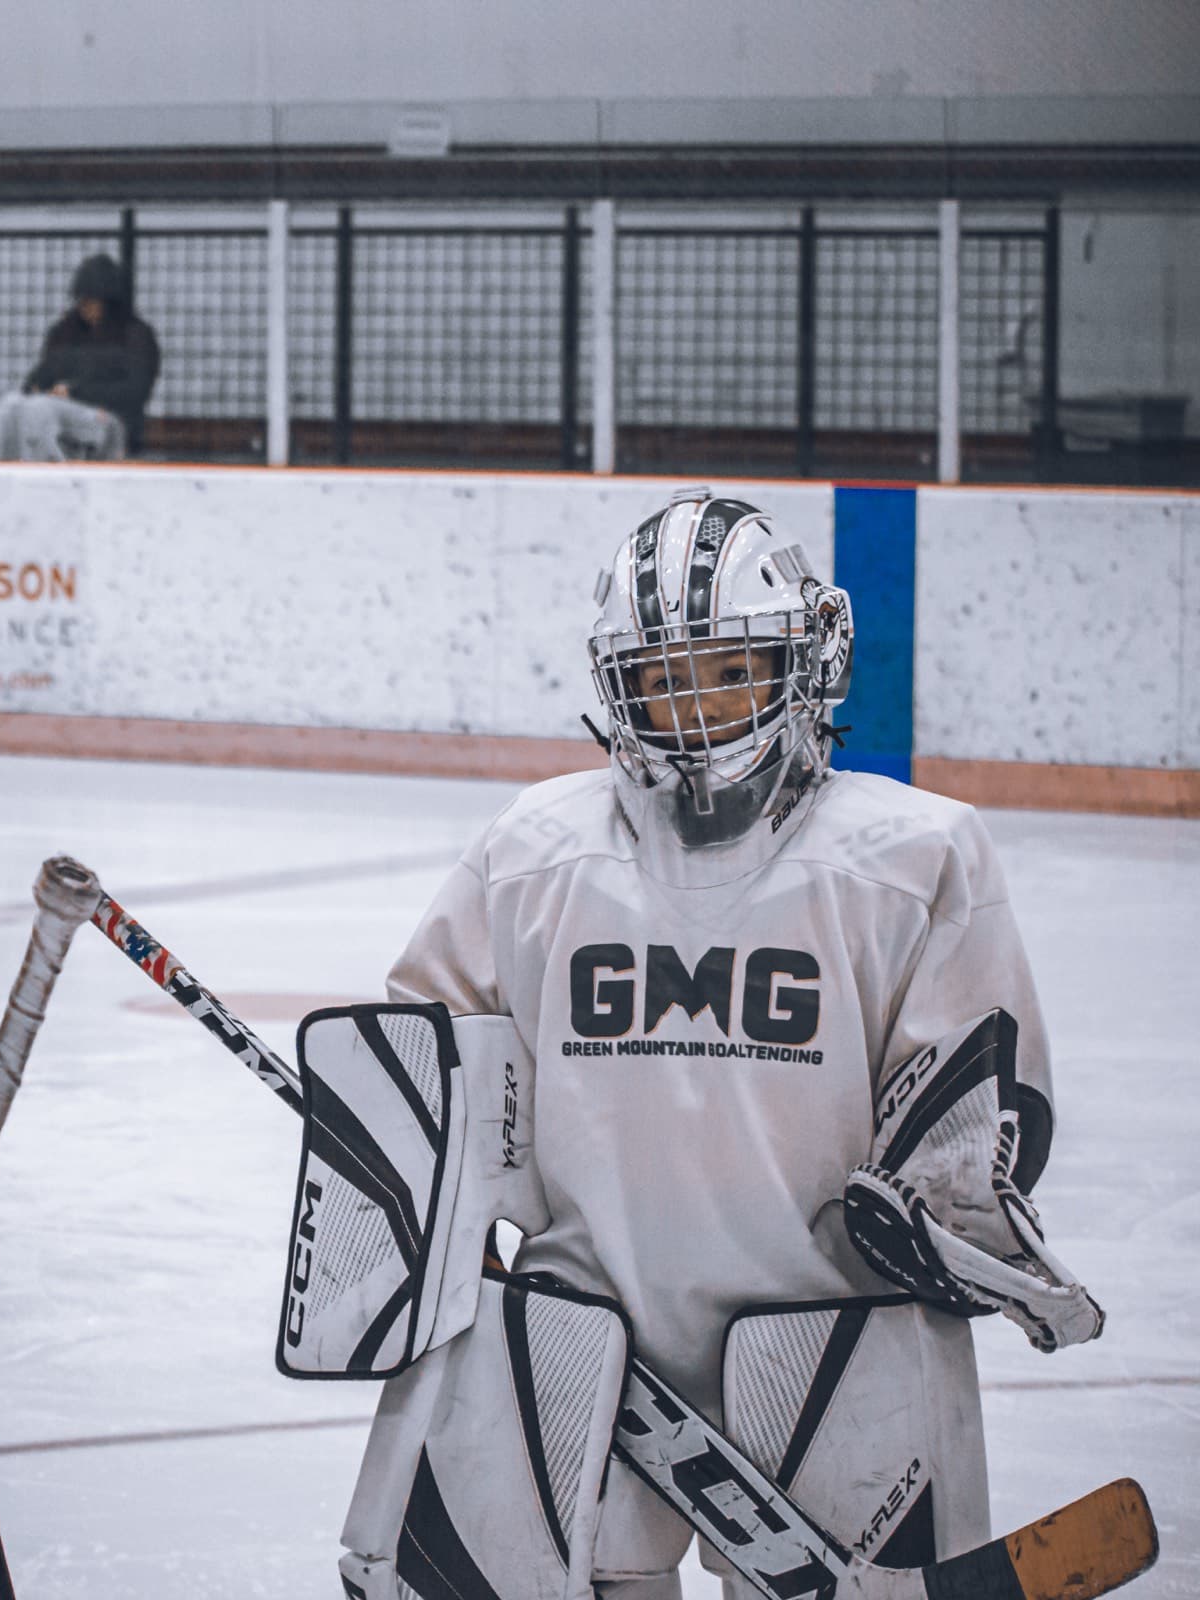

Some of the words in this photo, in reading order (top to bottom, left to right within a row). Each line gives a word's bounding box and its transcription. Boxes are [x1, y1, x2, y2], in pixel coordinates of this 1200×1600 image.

[569, 942, 821, 1046] GMG
[562, 1040, 614, 1057] GREEN
[616, 1040, 706, 1058] MOUNTAIN
[708, 1042, 825, 1066] GOALTENDING
[874, 1045, 938, 1138] CCM
[286, 1179, 323, 1348] CCM
